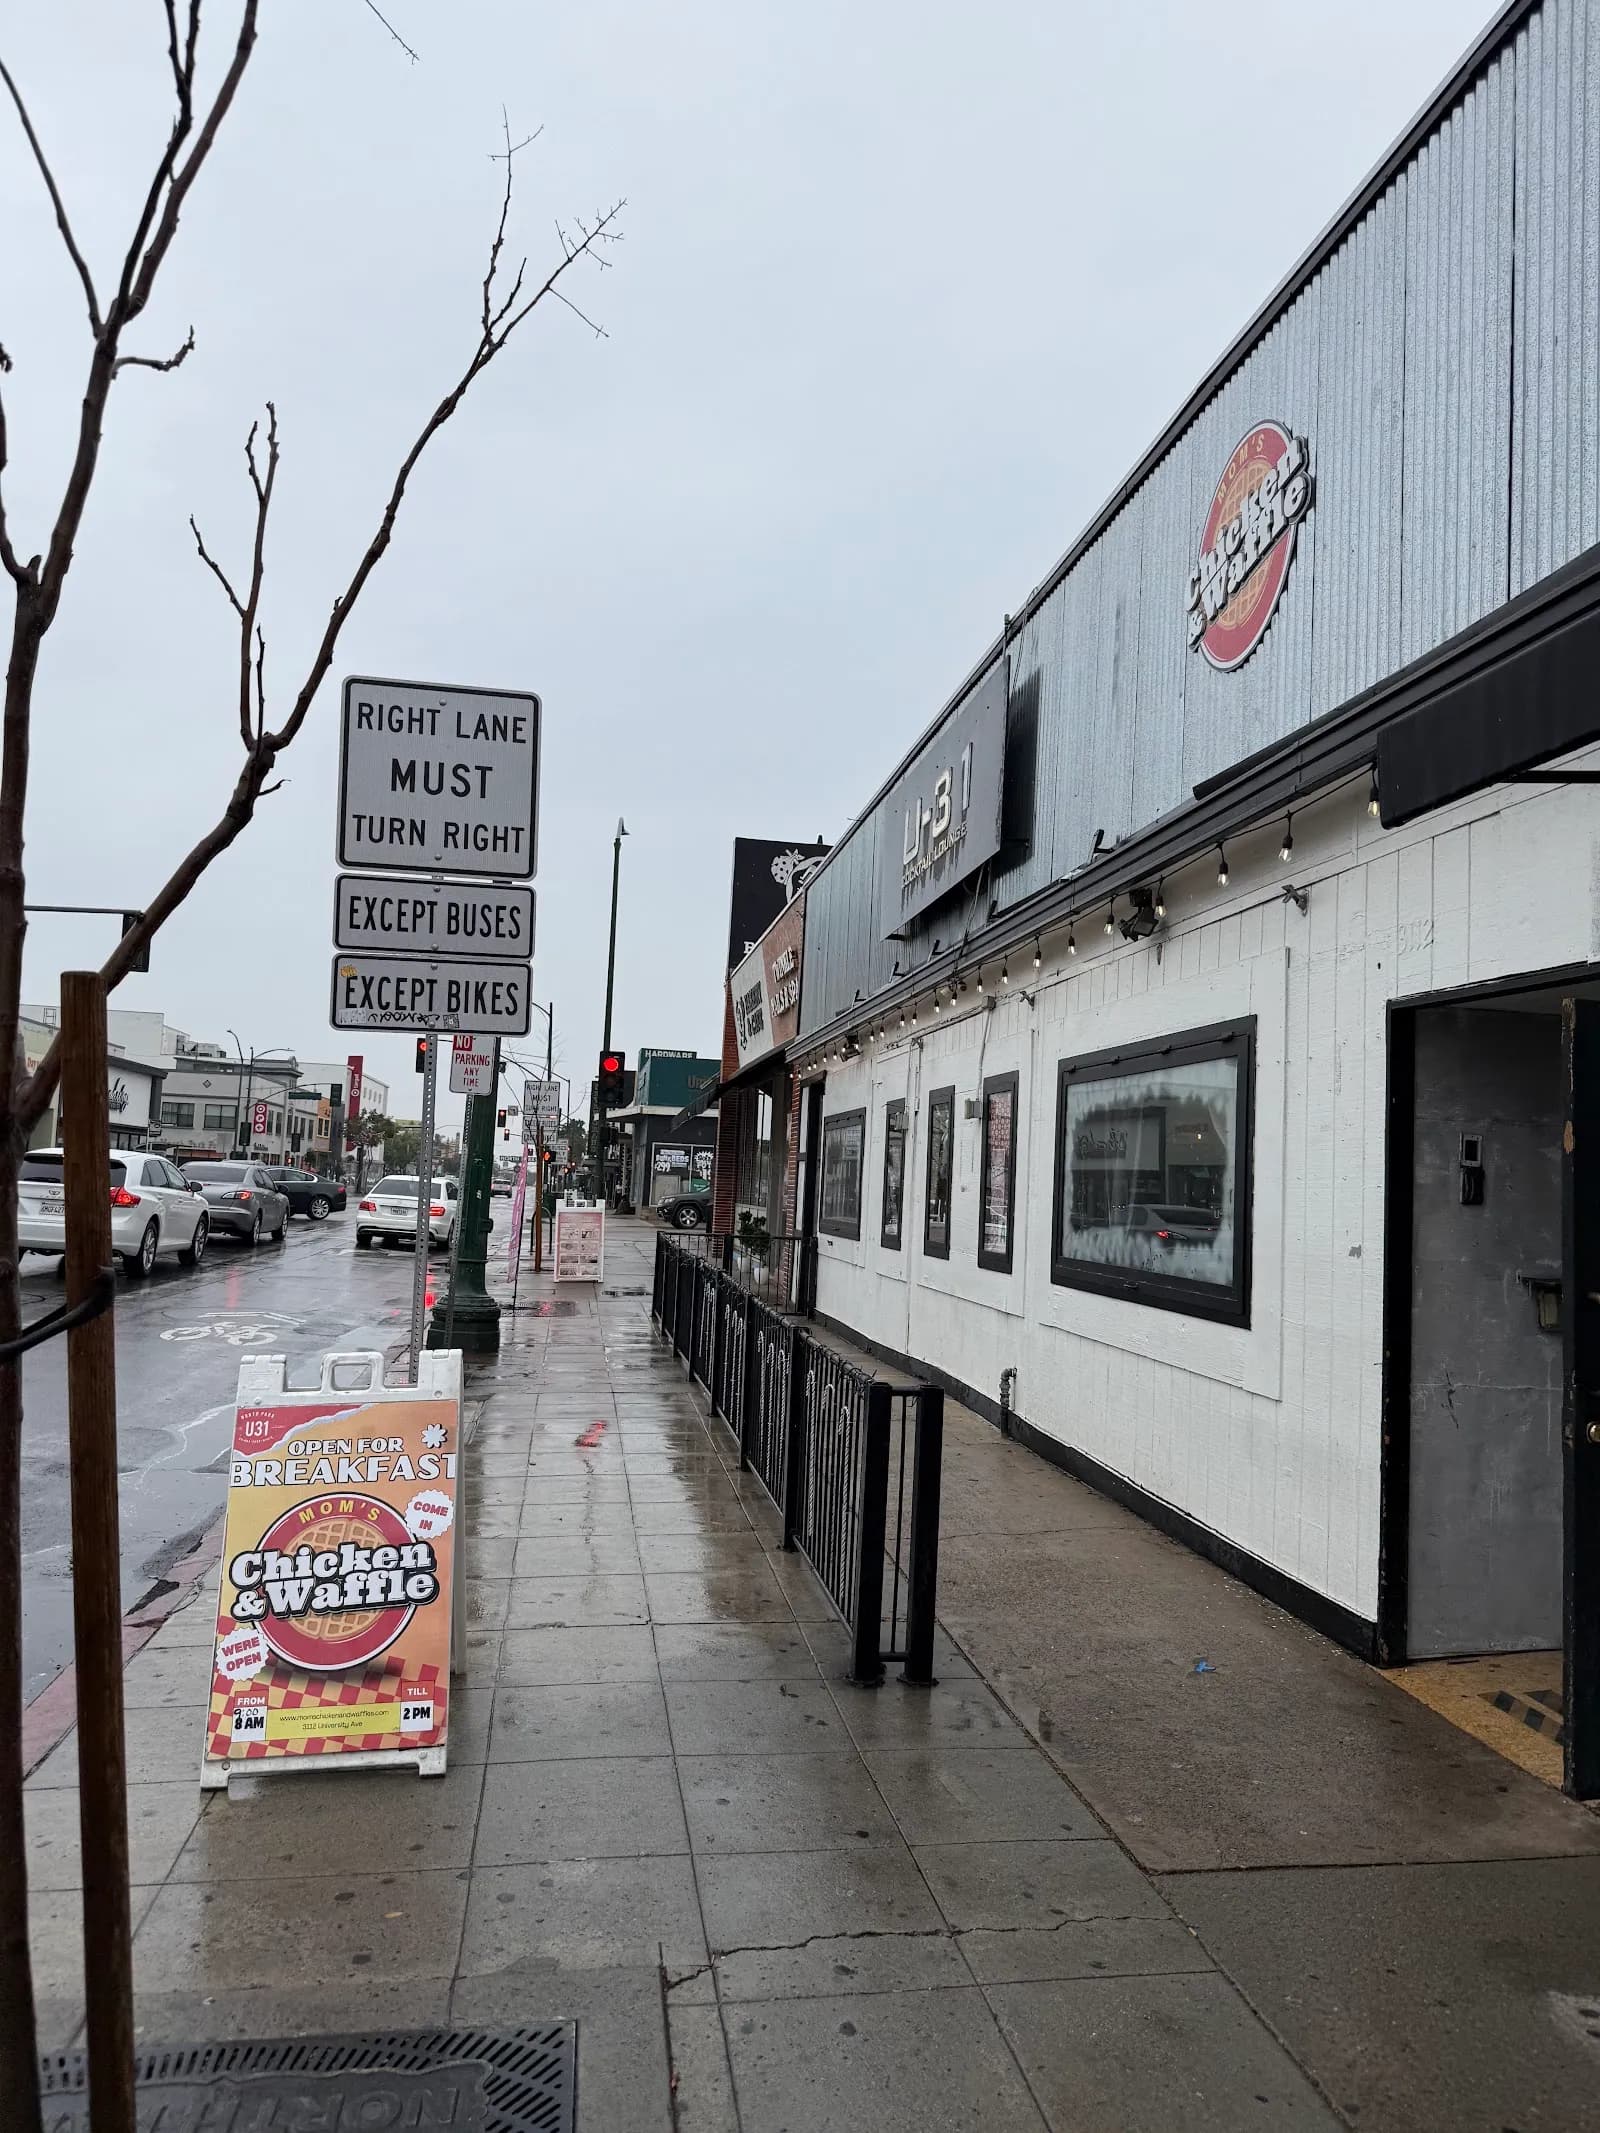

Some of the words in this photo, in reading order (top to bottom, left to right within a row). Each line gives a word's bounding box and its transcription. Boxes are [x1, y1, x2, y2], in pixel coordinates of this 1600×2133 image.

[1216, 433, 1266, 505] MOM'S
[1187, 439, 1302, 612] Chicken
[1200, 475, 1304, 619] Waffle
[357, 702, 441, 736] RIGHT
[456, 711, 527, 744] LANE
[390, 758, 493, 799] MUST
[903, 742, 974, 867] U-31
[352, 814, 426, 847] TURN
[443, 821, 525, 854] RIGHT
[933, 820, 968, 862] LOUNGE
[349, 895, 438, 934] EXCEPT
[447, 902, 521, 939] BUSES
[345, 975, 438, 1012] EXCEPT
[447, 979, 519, 1016] BIKES
[456, 1035, 471, 1049] NO
[455, 1053, 490, 1067] PARKING
[645, 1049, 693, 1059] HARDWARE
[464, 1067, 480, 1076] ANY
[464, 1077, 480, 1088] TIME
[245, 1421, 270, 1437] U31
[287, 1438, 352, 1456] OPEN
[357, 1436, 404, 1454] FOR
[230, 1452, 456, 1487] BREAKFAST
[300, 1498, 382, 1525] MOM'S
[413, 1501, 449, 1517] COME
[418, 1518, 434, 1531] IN
[230, 1540, 433, 1588] Chicken
[221, 1636, 261, 1656] WERE
[226, 1651, 262, 1671] OPEN
[237, 1696, 265, 1706] FROM
[407, 1688, 429, 1696] TILL
[233, 1708, 259, 1719] 9:00
[234, 1717, 243, 1730] 8
[244, 1716, 265, 1730] AM
[403, 1708, 411, 1720] 2
[412, 1706, 431, 1720] PM
[318, 1720, 350, 1731] University
[350, 1720, 363, 1729] Ave
